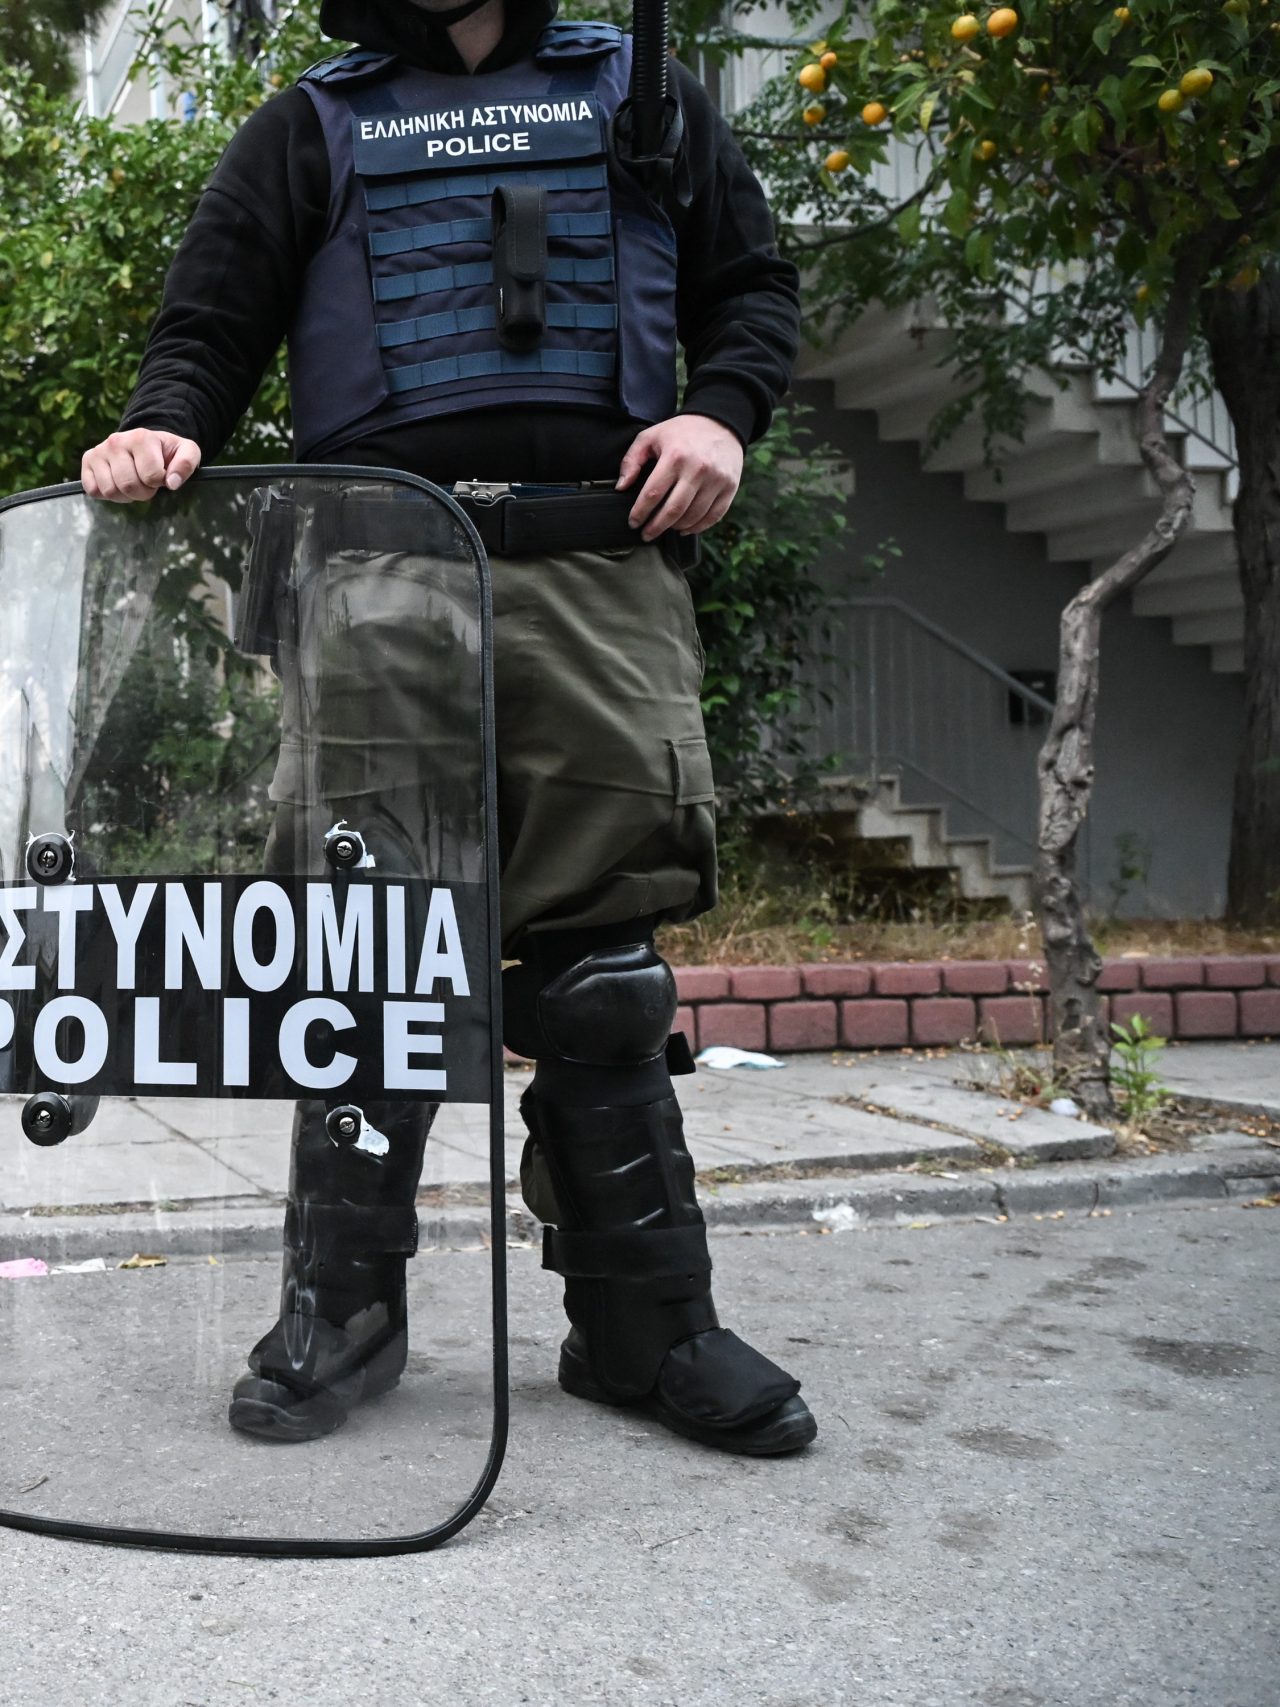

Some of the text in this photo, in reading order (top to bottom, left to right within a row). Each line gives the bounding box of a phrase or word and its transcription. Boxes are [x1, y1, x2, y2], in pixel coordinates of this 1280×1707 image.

[360, 100, 593, 140] ΕΛΛΗΝΙΚΗ ΑΣΤΥΝΟΜΙΑ
[426, 132, 531, 158] POLICE
